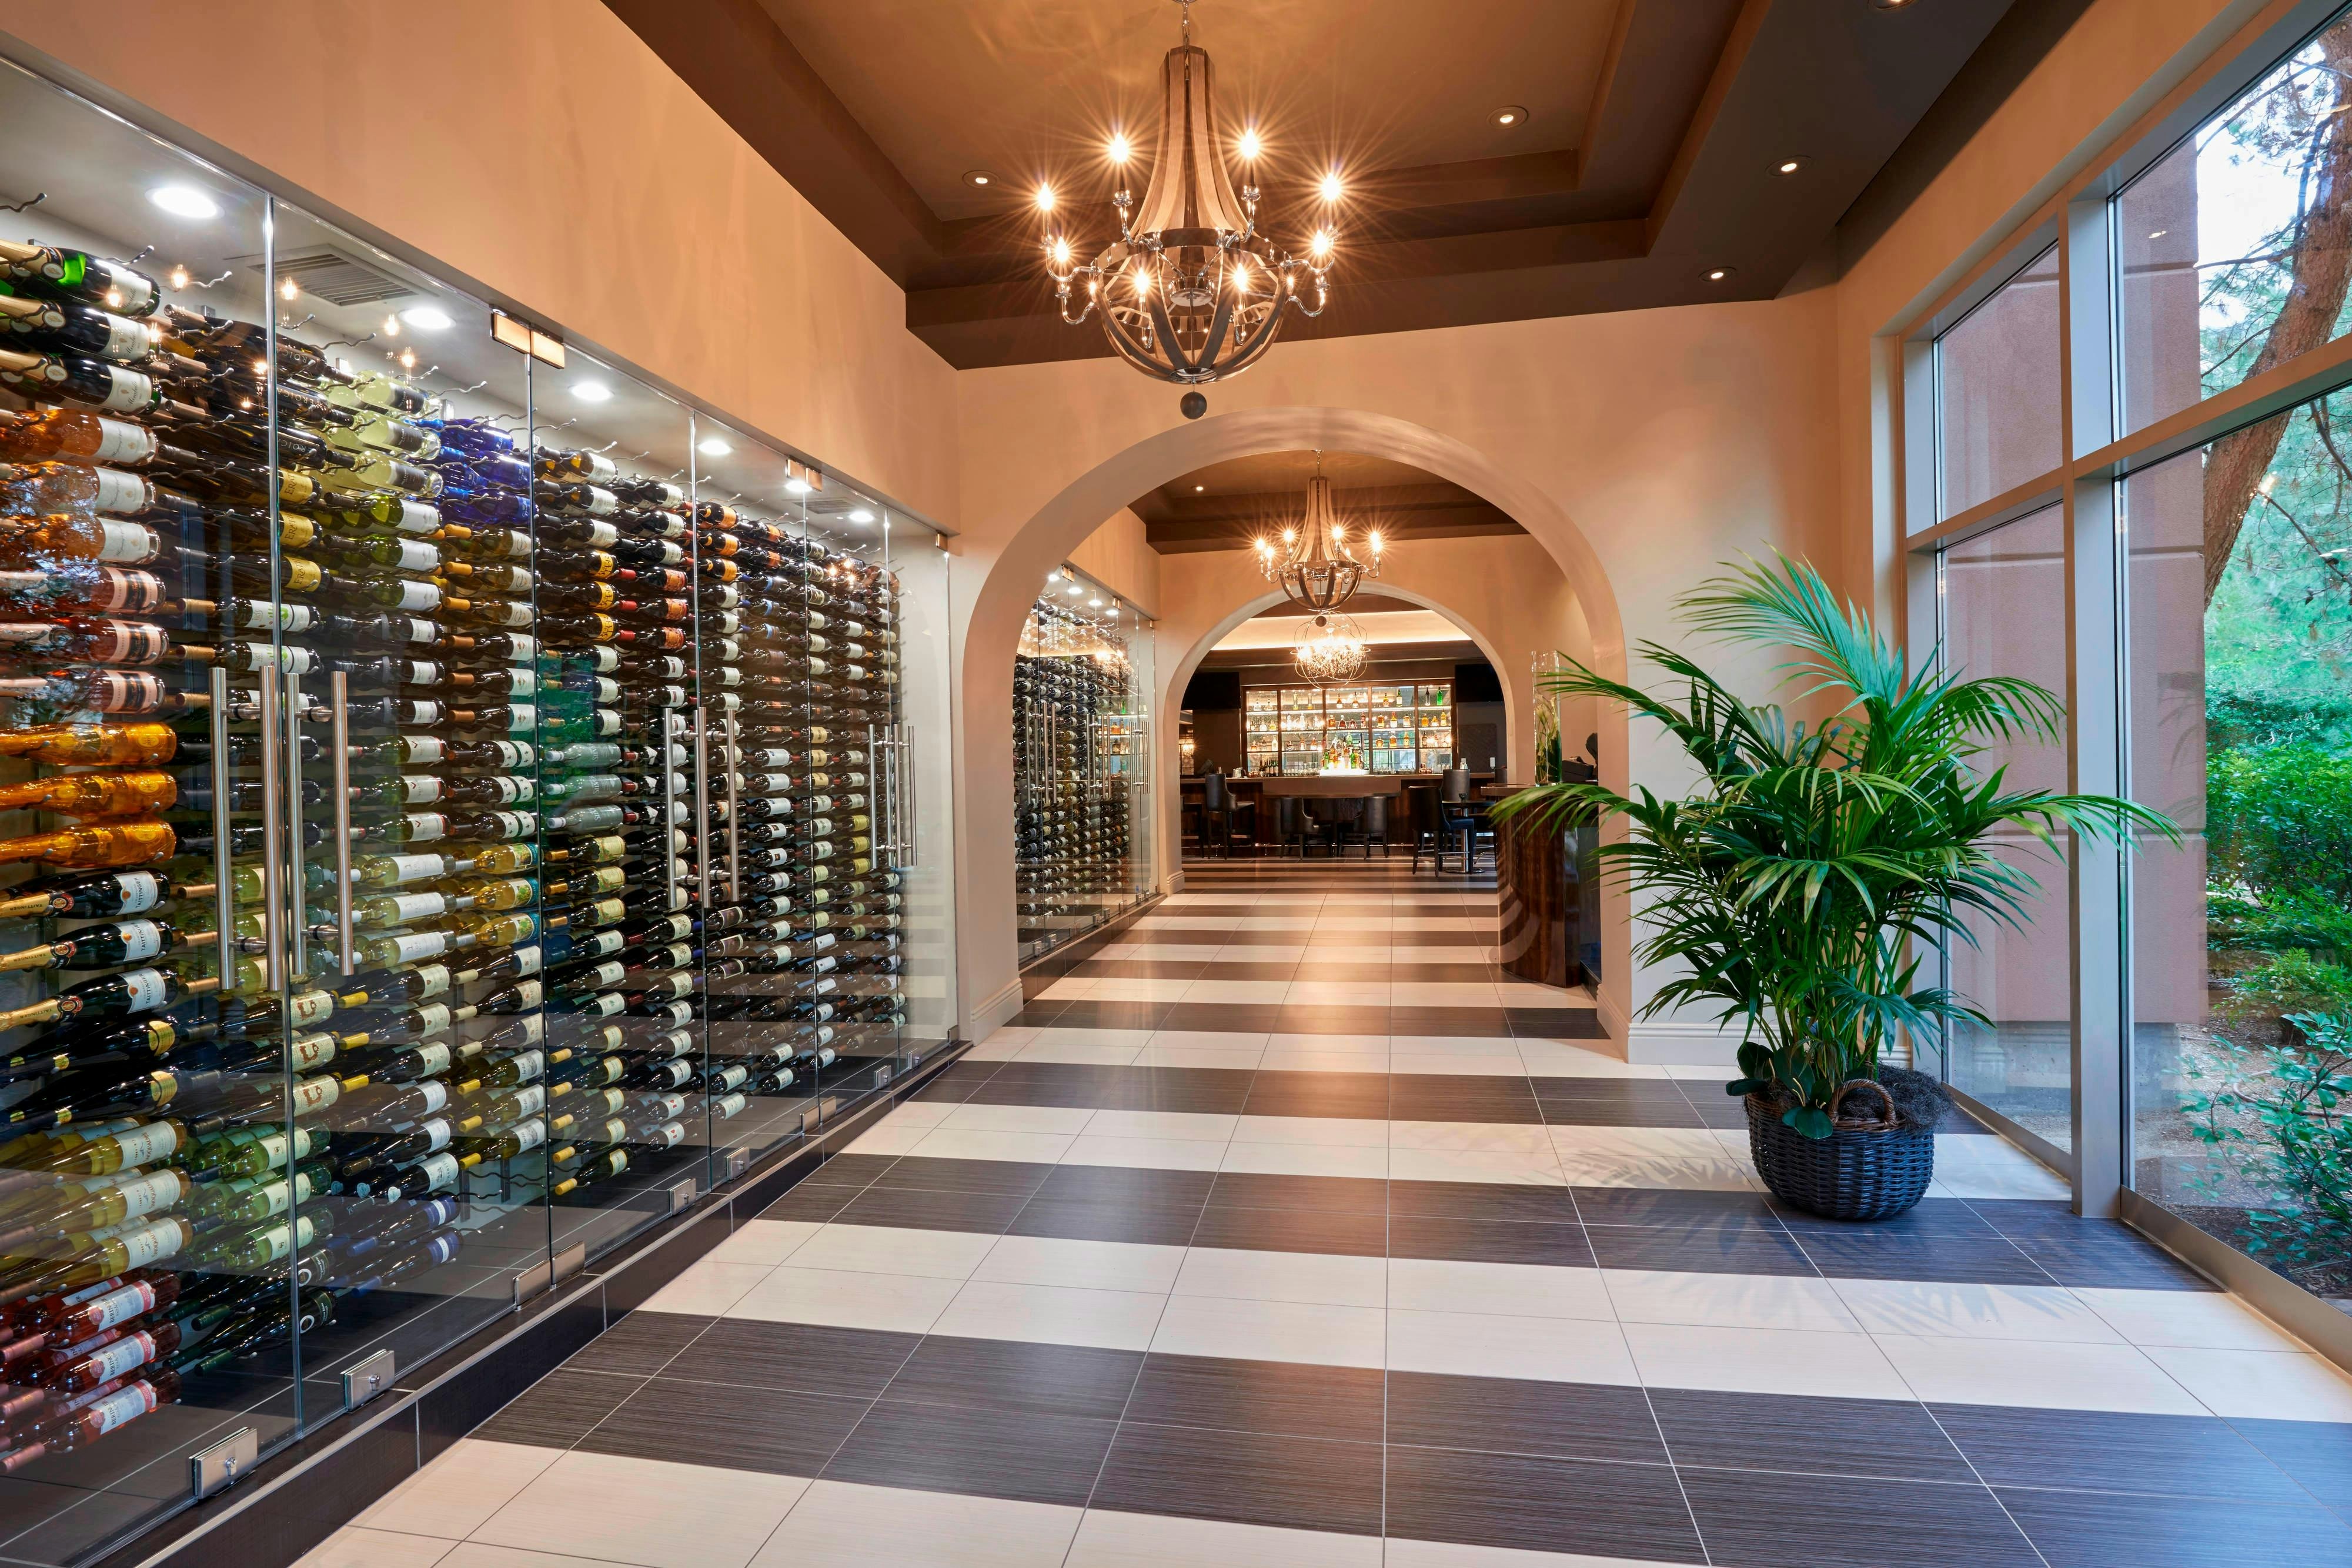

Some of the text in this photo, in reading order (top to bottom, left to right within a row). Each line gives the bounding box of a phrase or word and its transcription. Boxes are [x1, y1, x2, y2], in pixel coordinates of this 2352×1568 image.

[133, 877, 142, 908] TAITTINGER
[14, 952, 47, 962] TAITTINGER
[19, 1008, 52, 1018] TAITTINGER
